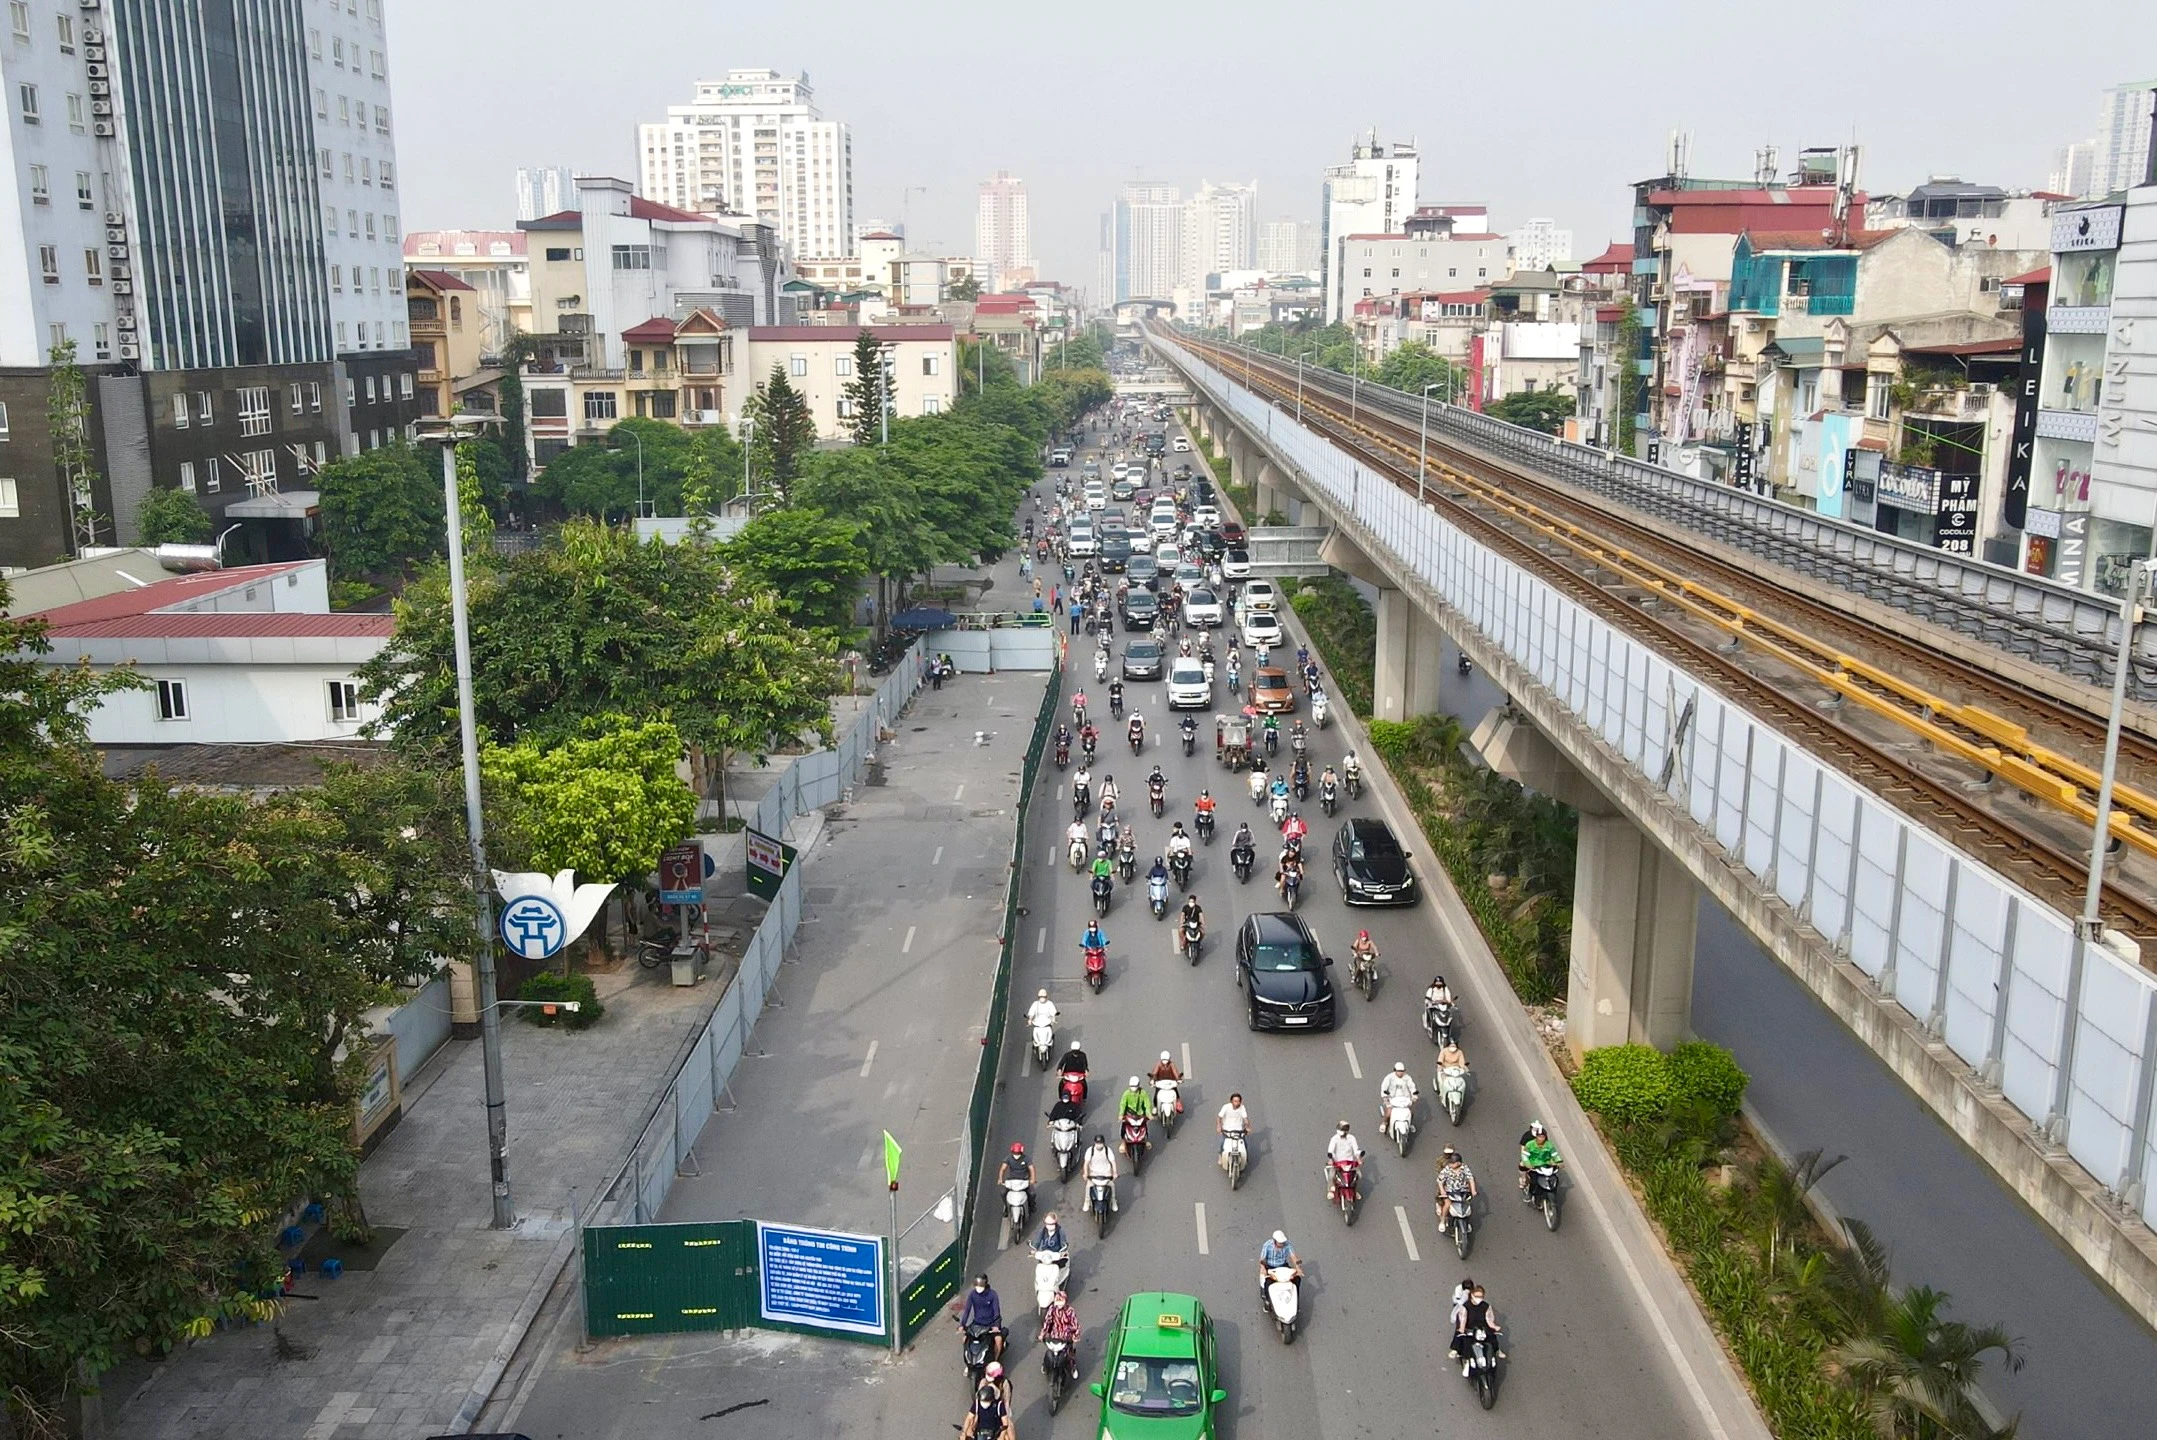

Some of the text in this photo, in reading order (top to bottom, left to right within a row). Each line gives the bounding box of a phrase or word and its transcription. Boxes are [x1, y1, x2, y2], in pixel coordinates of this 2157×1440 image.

[2012, 348, 2038, 491] LEIKA
[1845, 451, 1854, 489] LYRA
[1879, 473, 1929, 501] COCOLUX
[1941, 494, 1977, 512] PHẨM
[1942, 539, 1969, 551] 208
